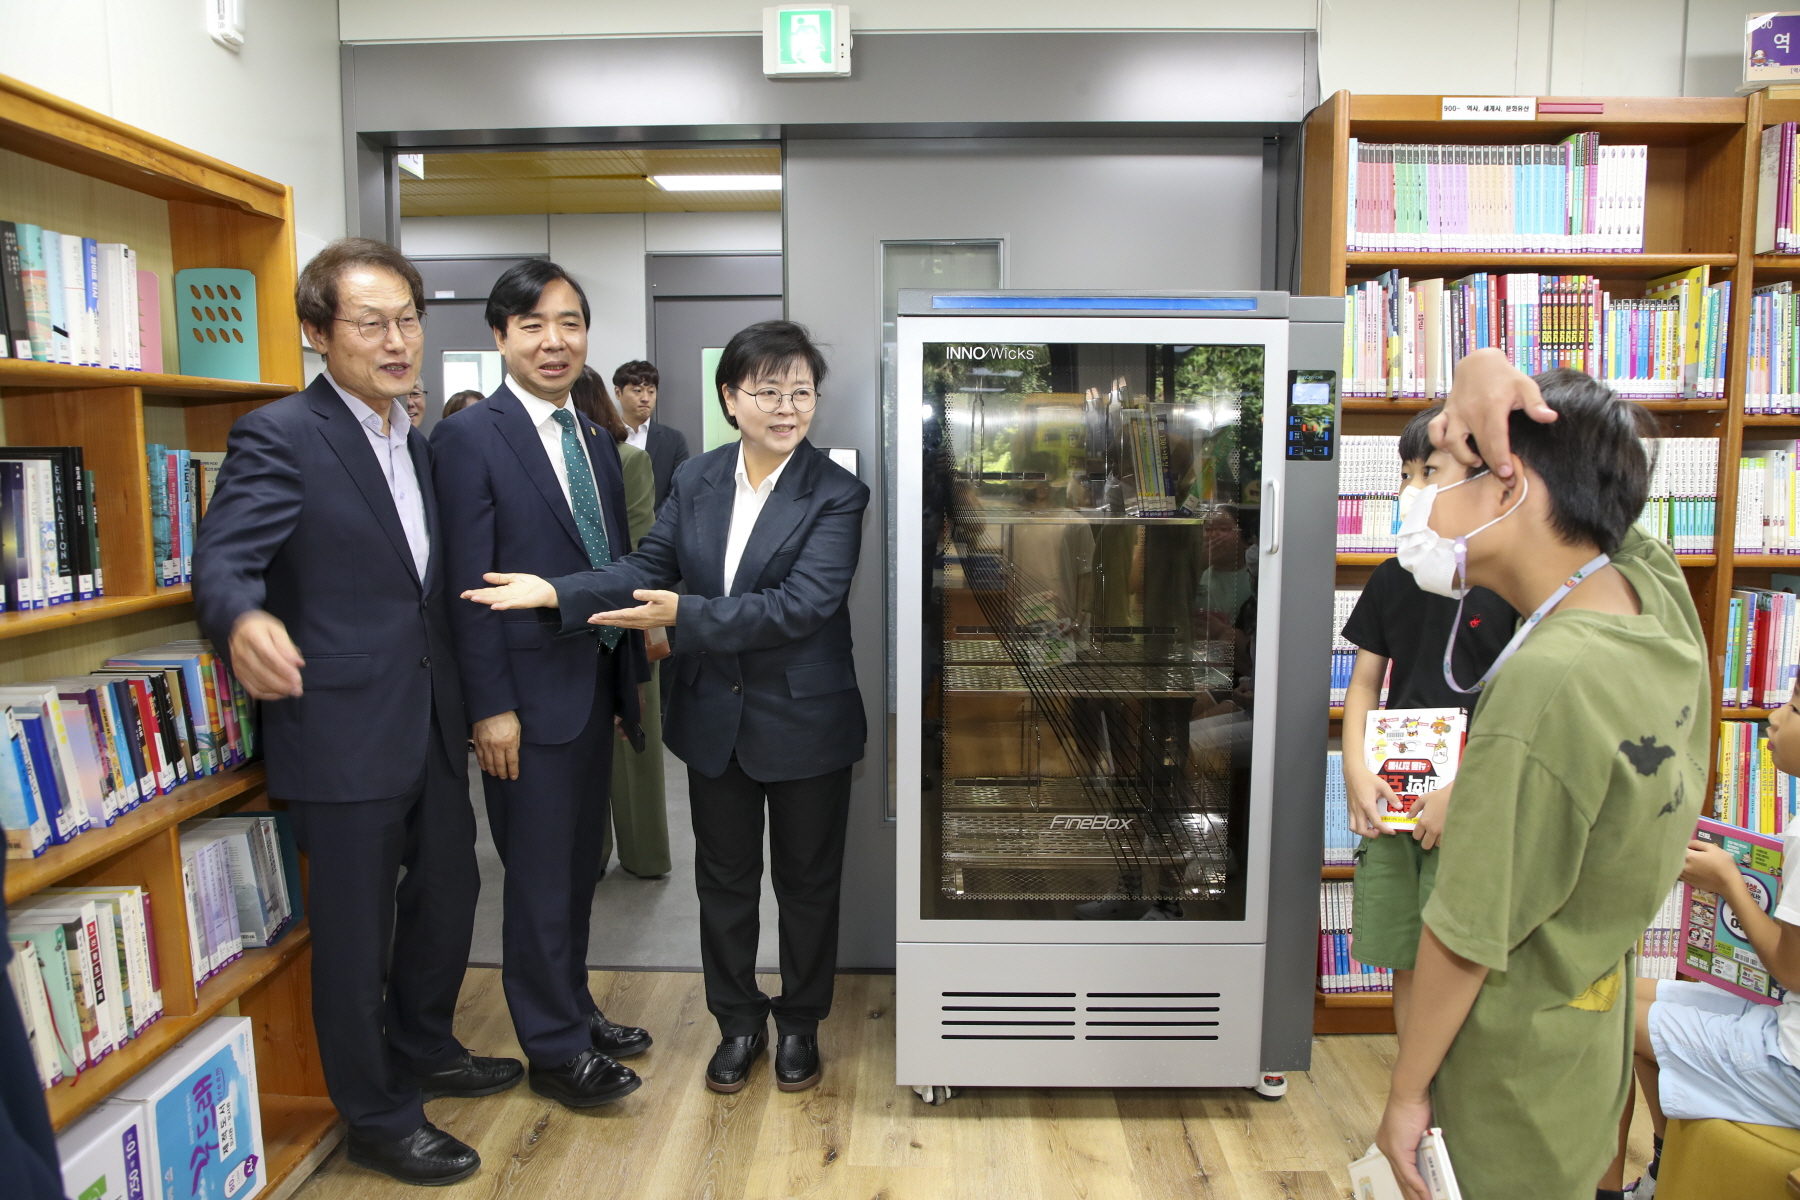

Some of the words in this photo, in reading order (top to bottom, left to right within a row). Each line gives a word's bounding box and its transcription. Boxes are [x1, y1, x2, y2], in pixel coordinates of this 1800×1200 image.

[1774, 32, 1790, 54] 역
[54, 465, 67, 560] EXHALATION
[1388, 761, 1411, 770] 첨가물
[1411, 761, 1426, 770] 식품
[1376, 774, 1405, 792] 도
[1406, 774, 1440, 793] 과학
[1050, 815, 1133, 830] FineBox
[246, 1158, 254, 1174] A4
